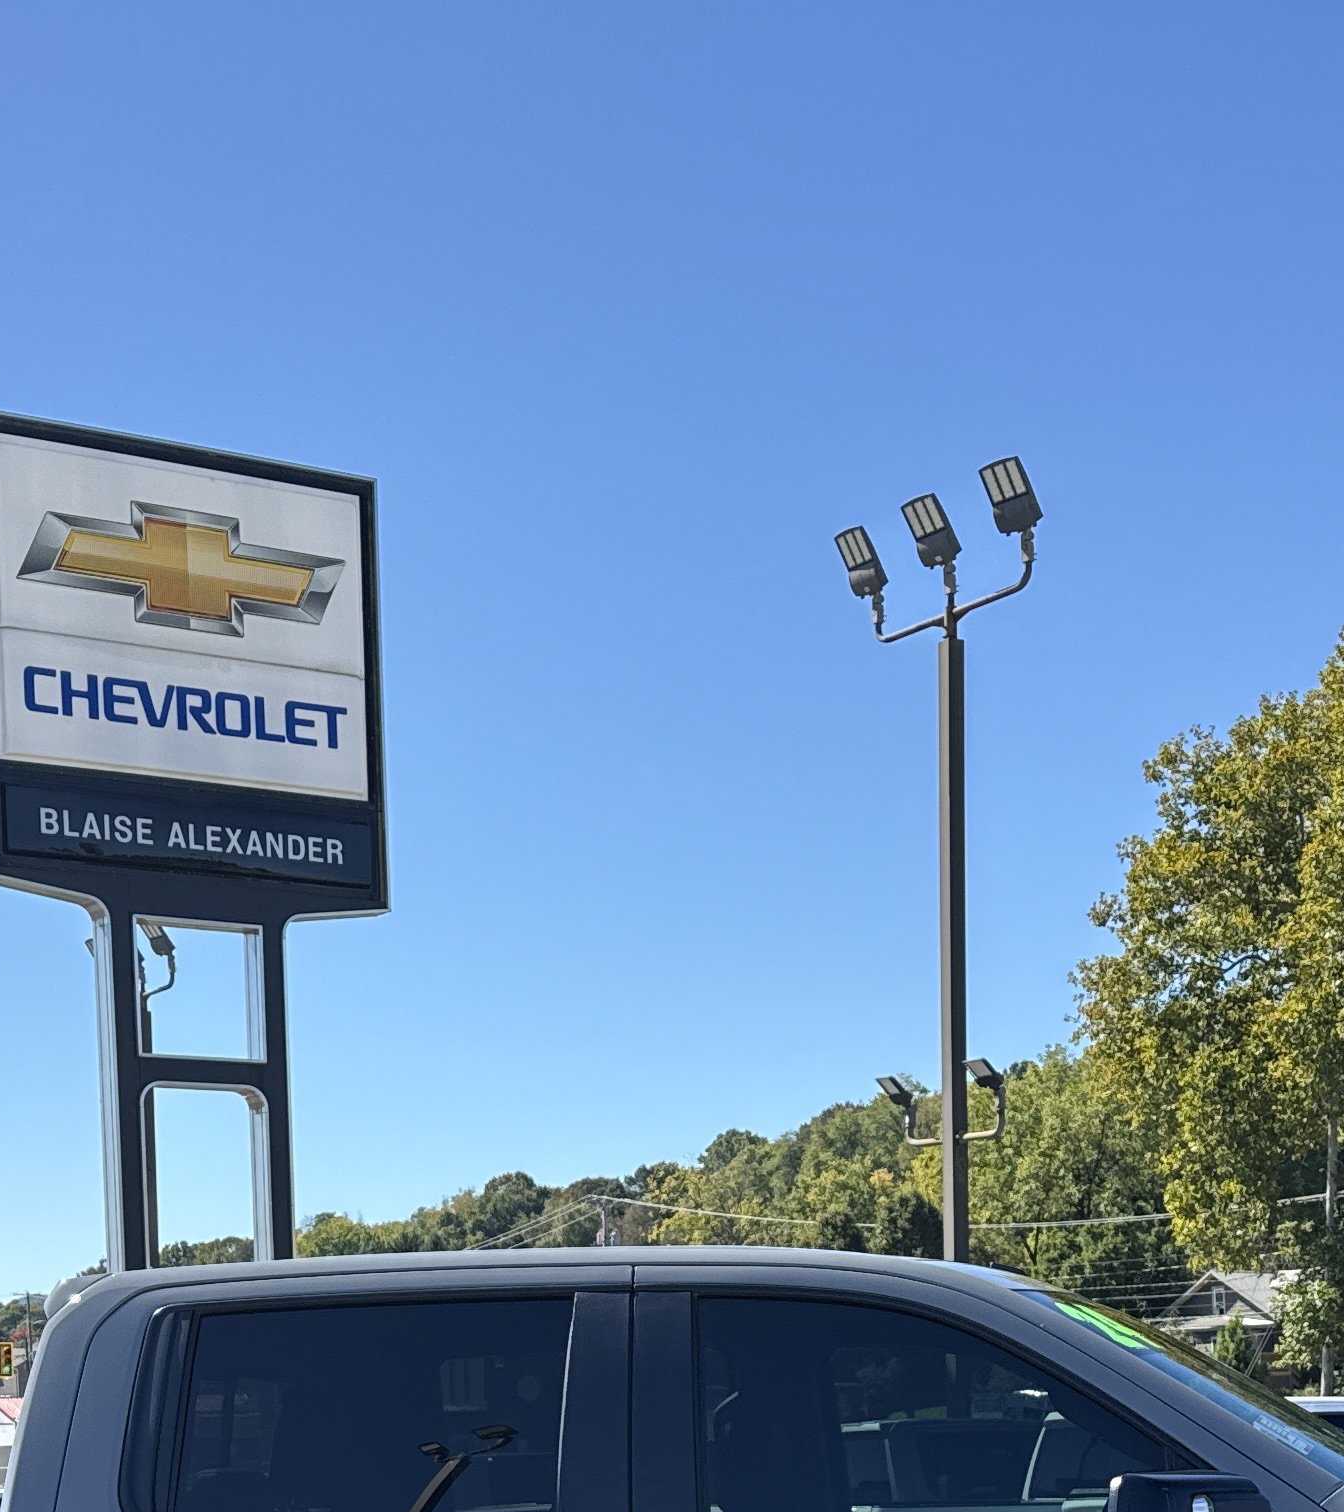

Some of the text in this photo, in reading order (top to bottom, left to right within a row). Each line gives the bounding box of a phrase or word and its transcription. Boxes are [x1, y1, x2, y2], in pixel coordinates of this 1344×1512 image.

[23, 665, 348, 749] CHEVROLET
[39, 806, 345, 866] BLAISE ALEXANDER
